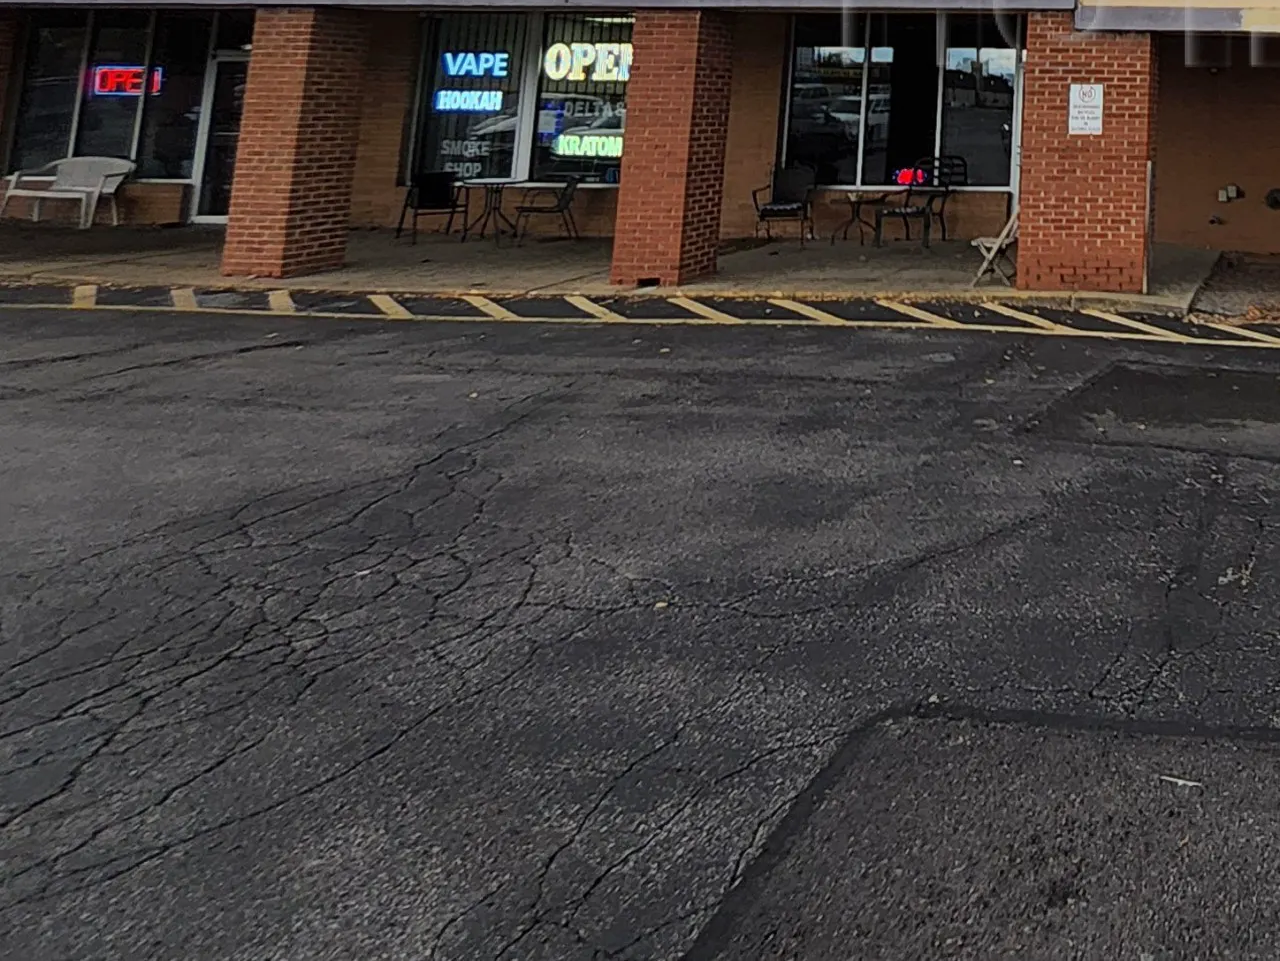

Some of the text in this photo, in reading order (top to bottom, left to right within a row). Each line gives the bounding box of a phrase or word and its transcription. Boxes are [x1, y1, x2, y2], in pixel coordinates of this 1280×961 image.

[444, 52, 509, 77] VAPE
[436, 90, 503, 111] HOOKAH
[564, 101, 613, 117] DELTA
[441, 139, 490, 157] SMOKE
[558, 134, 623, 157] KRATOM
